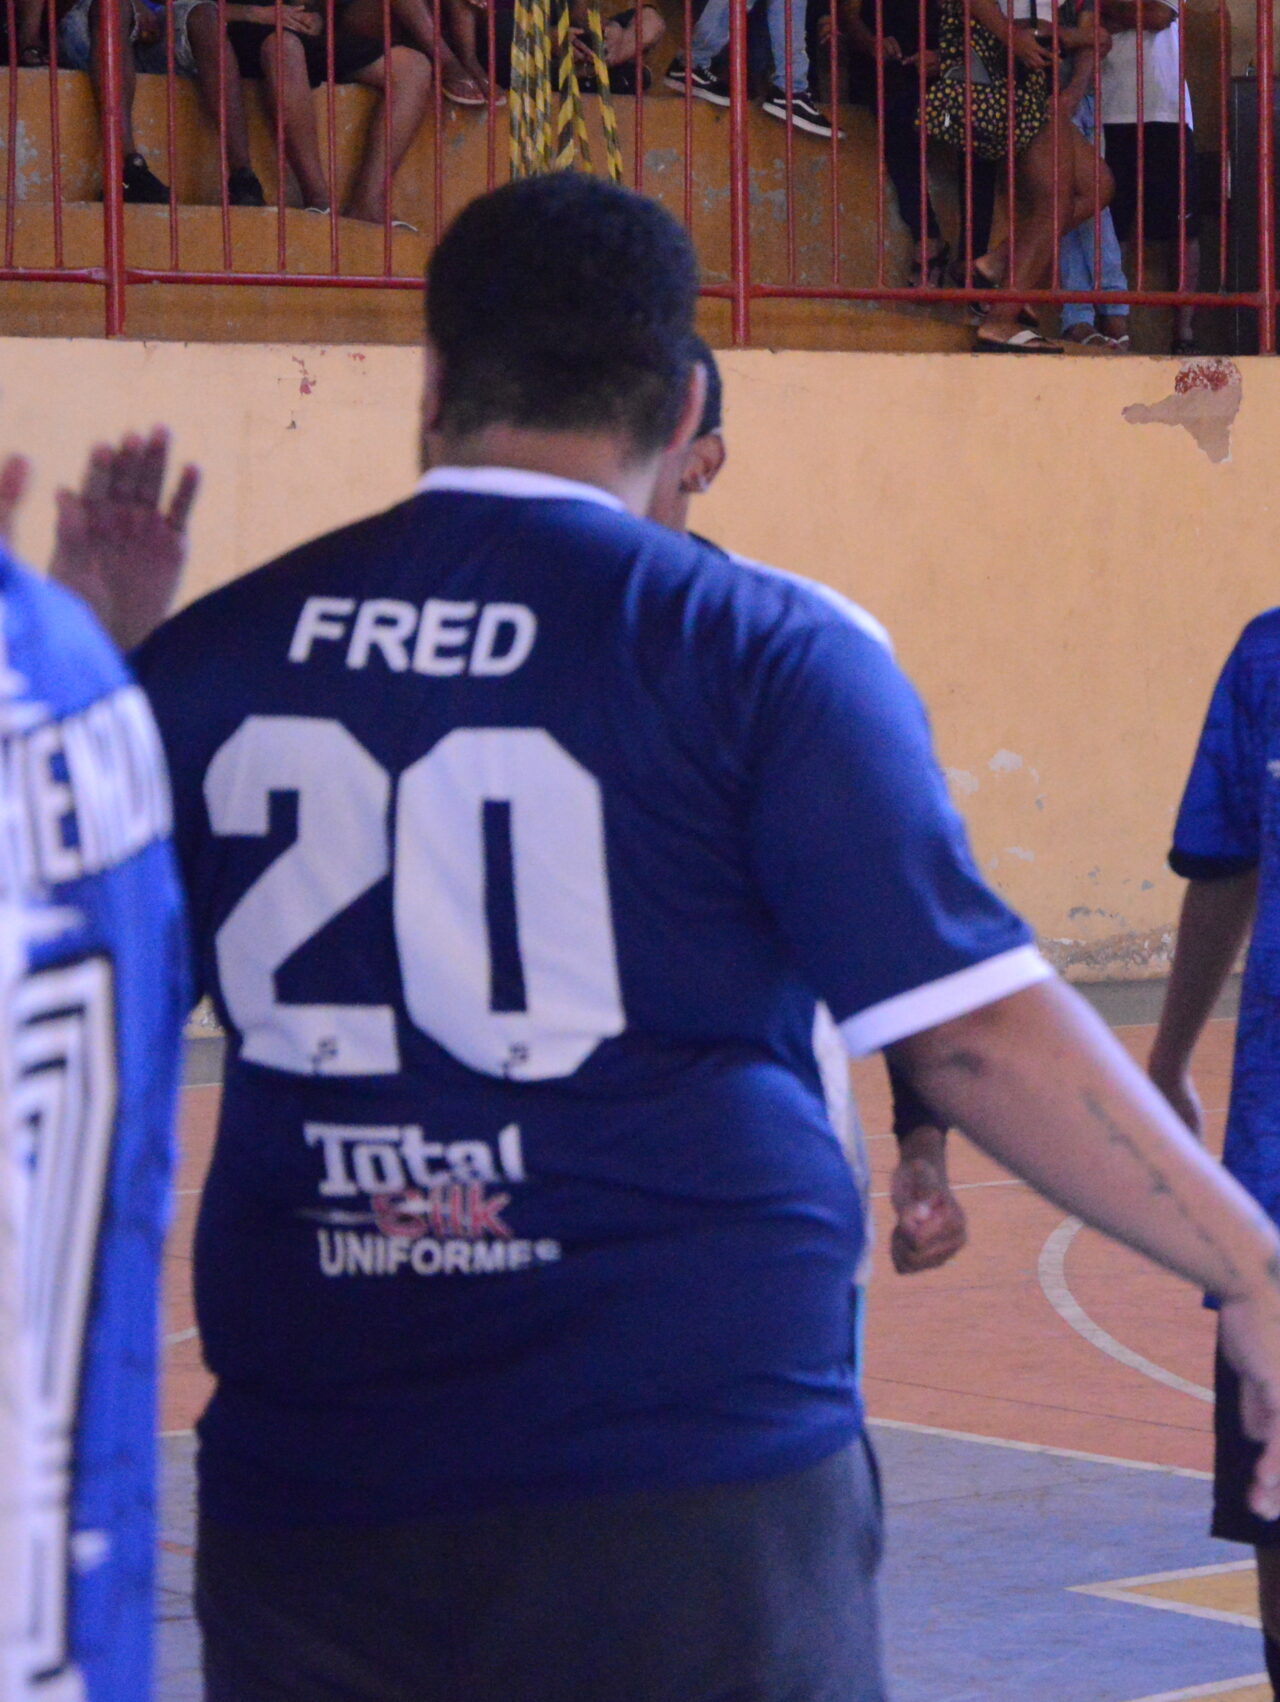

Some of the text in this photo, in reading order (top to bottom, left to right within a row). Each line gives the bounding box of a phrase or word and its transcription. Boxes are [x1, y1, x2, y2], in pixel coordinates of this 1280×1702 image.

[288, 597, 538, 676] FRED
[203, 715, 626, 1082] 20
[302, 1122, 527, 1197] Total
